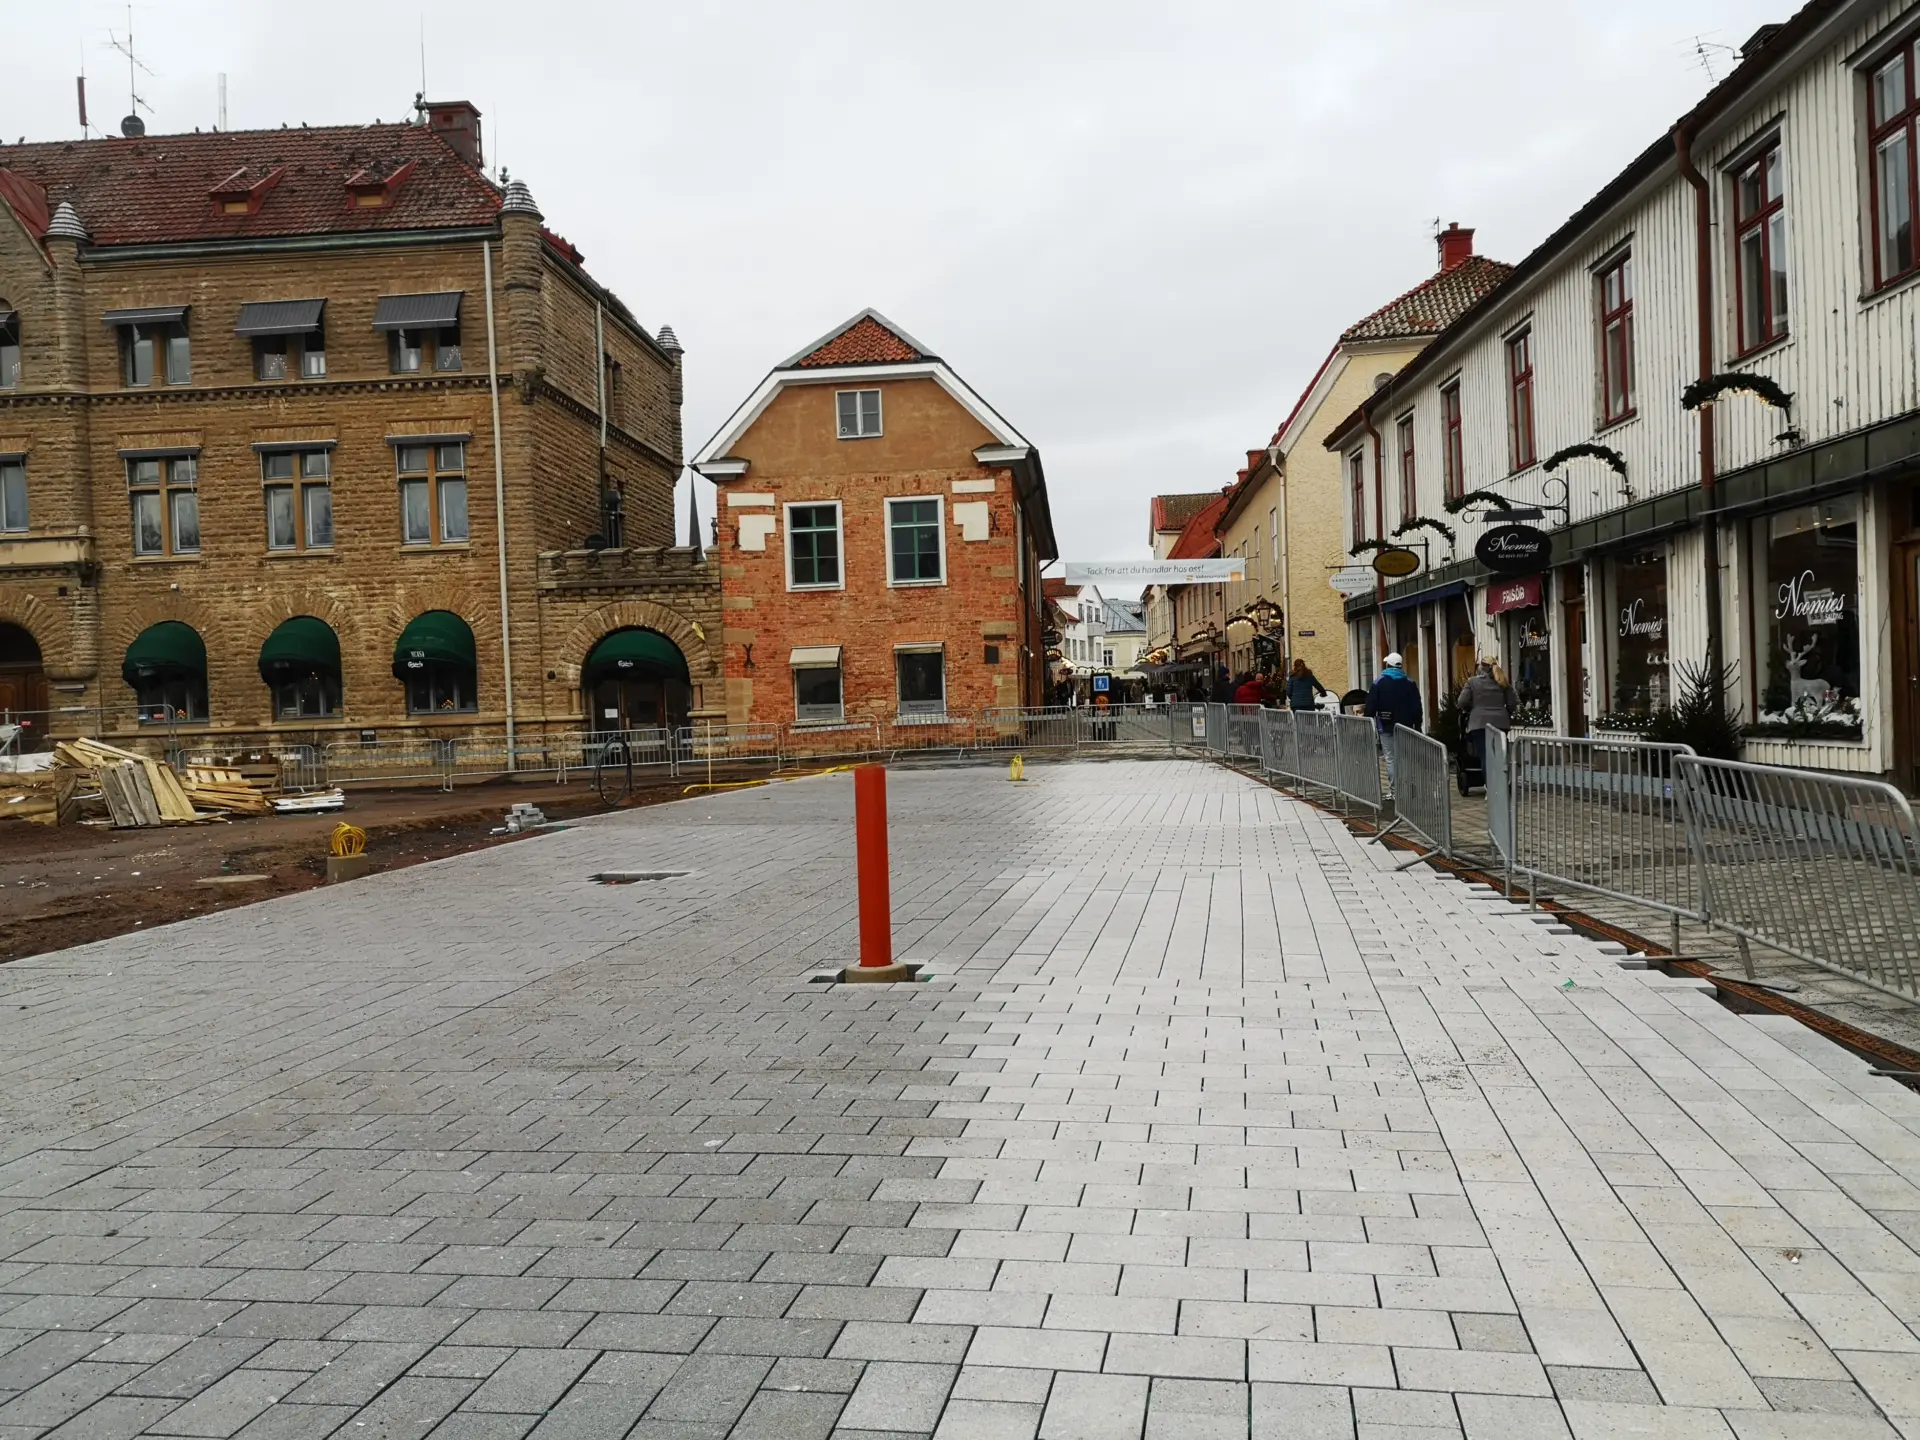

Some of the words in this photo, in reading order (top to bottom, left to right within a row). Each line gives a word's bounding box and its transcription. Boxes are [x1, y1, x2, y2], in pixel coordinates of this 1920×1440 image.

[1488, 533, 1539, 551] Noomies
[1087, 567, 1103, 575] Tack
[1117, 567, 1129, 575] att
[1130, 566, 1141, 574] du
[1142, 565, 1171, 574] handlar
[1173, 565, 1187, 573] hos
[1188, 564, 1204, 573] oss!
[1775, 569, 1845, 619] Noomies
[1619, 598, 1663, 637] Noomies
